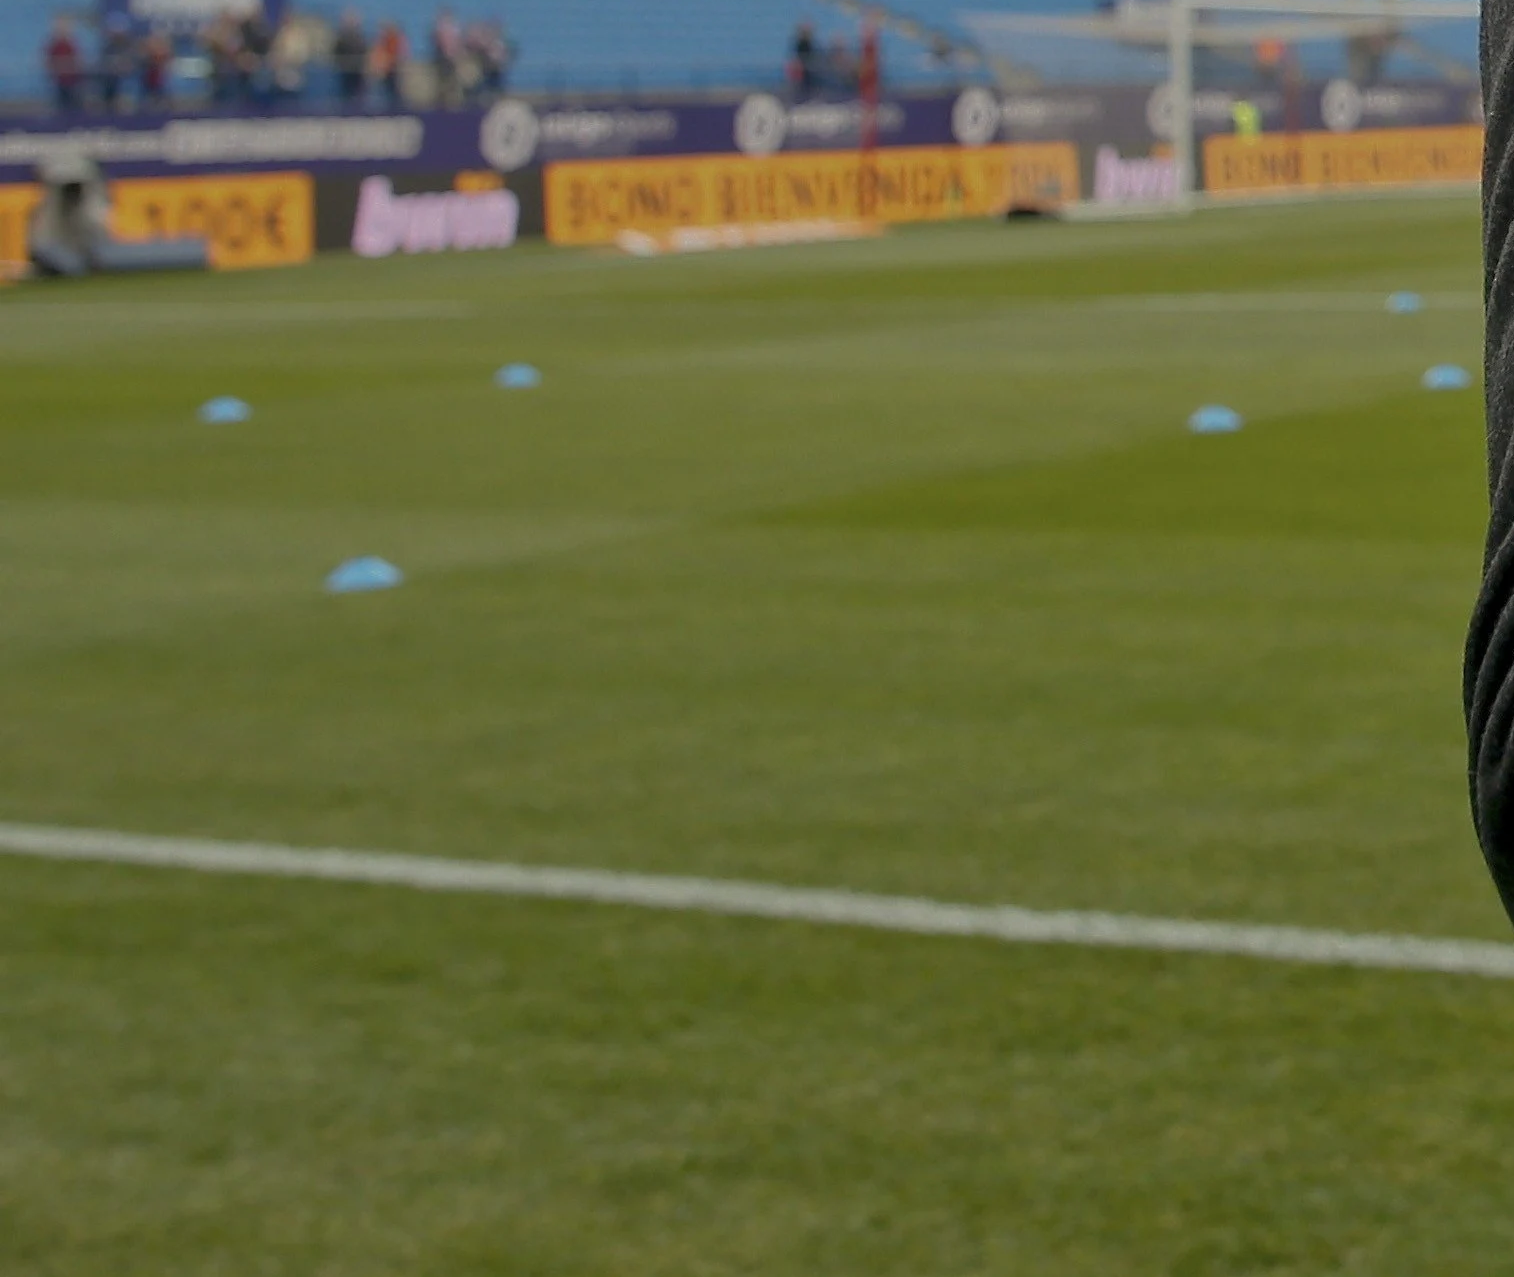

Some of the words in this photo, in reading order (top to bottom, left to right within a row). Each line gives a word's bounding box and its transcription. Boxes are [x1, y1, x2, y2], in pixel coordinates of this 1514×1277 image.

[352, 174, 520, 258] bwin
[568, 172, 693, 225] BONO
[715, 162, 972, 225] BIENVENIDA
